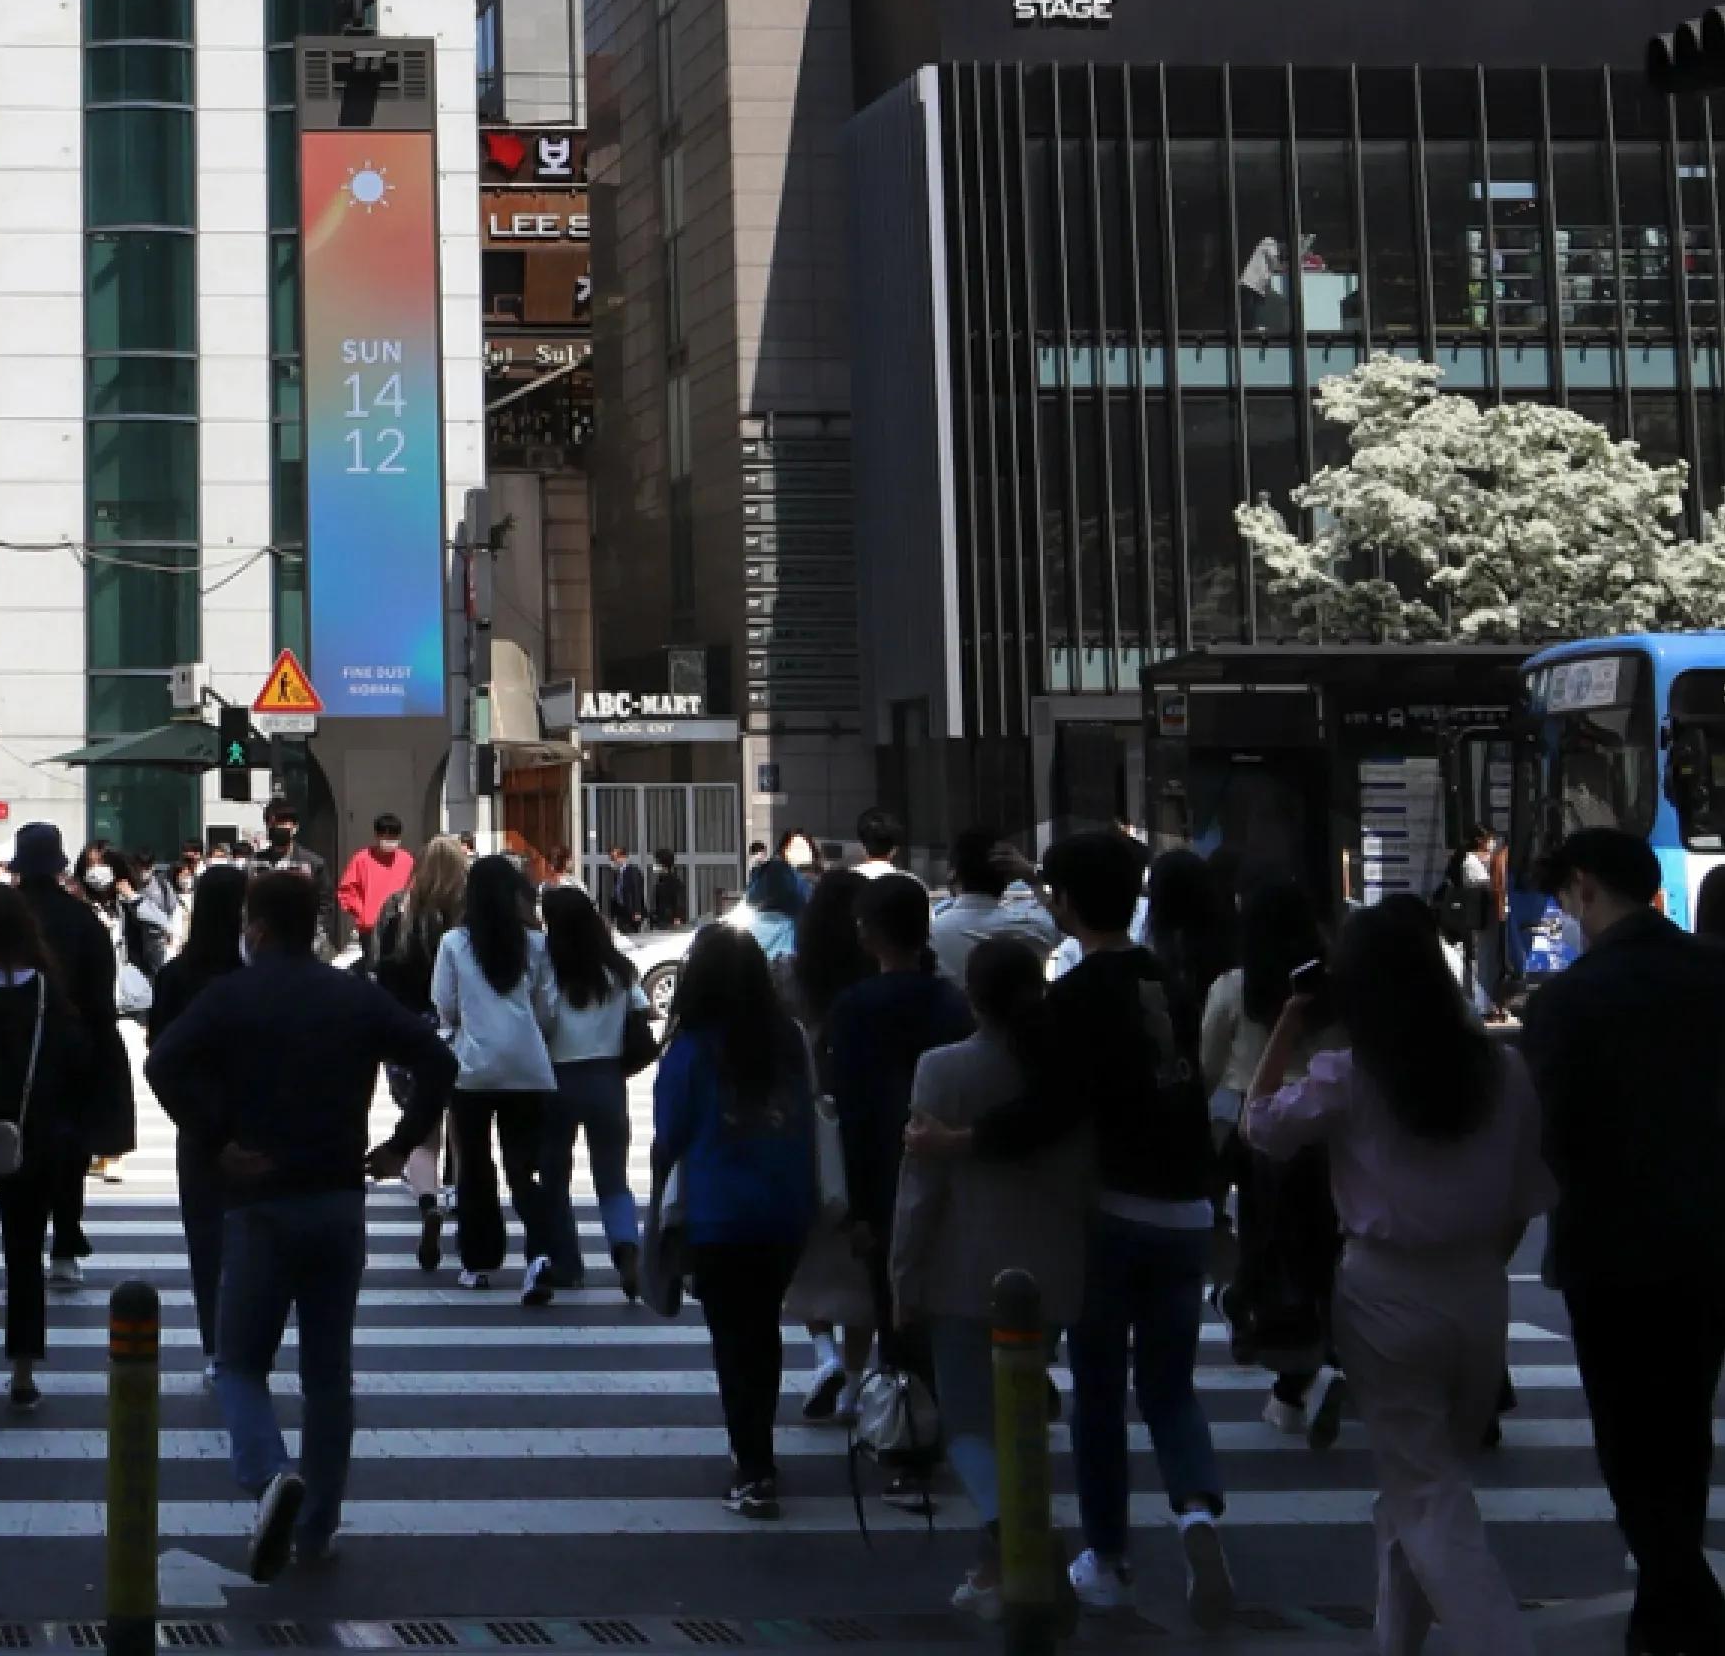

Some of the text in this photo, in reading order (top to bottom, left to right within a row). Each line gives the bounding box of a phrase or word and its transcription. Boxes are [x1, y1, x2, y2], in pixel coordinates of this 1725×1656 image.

[341, 340, 403, 363] SUN
[343, 372, 406, 418] 14
[344, 428, 407, 475] 12
[342, 665, 373, 680] FINE
